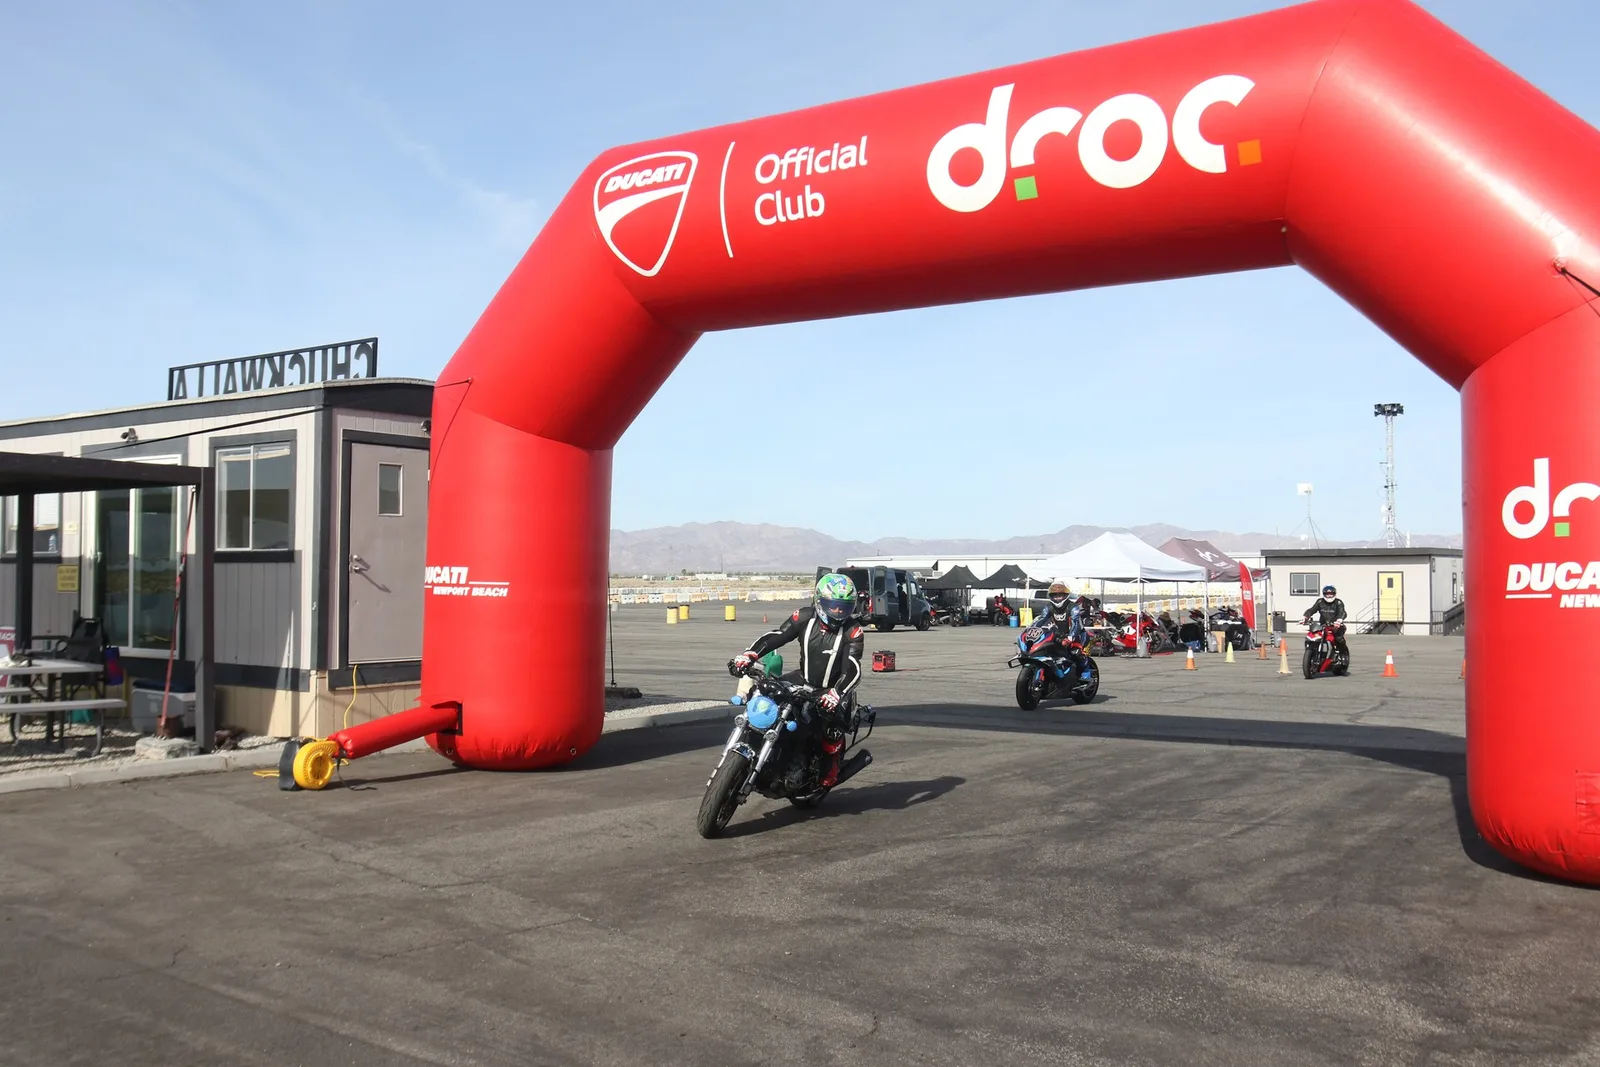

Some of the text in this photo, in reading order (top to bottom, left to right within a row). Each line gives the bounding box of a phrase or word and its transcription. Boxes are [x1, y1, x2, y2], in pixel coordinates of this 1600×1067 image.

[604, 162, 686, 193] DUCATI
[755, 136, 868, 185] Official
[755, 185, 825, 226] Club
[433, 586, 509, 597] NEWPORT BEACH
